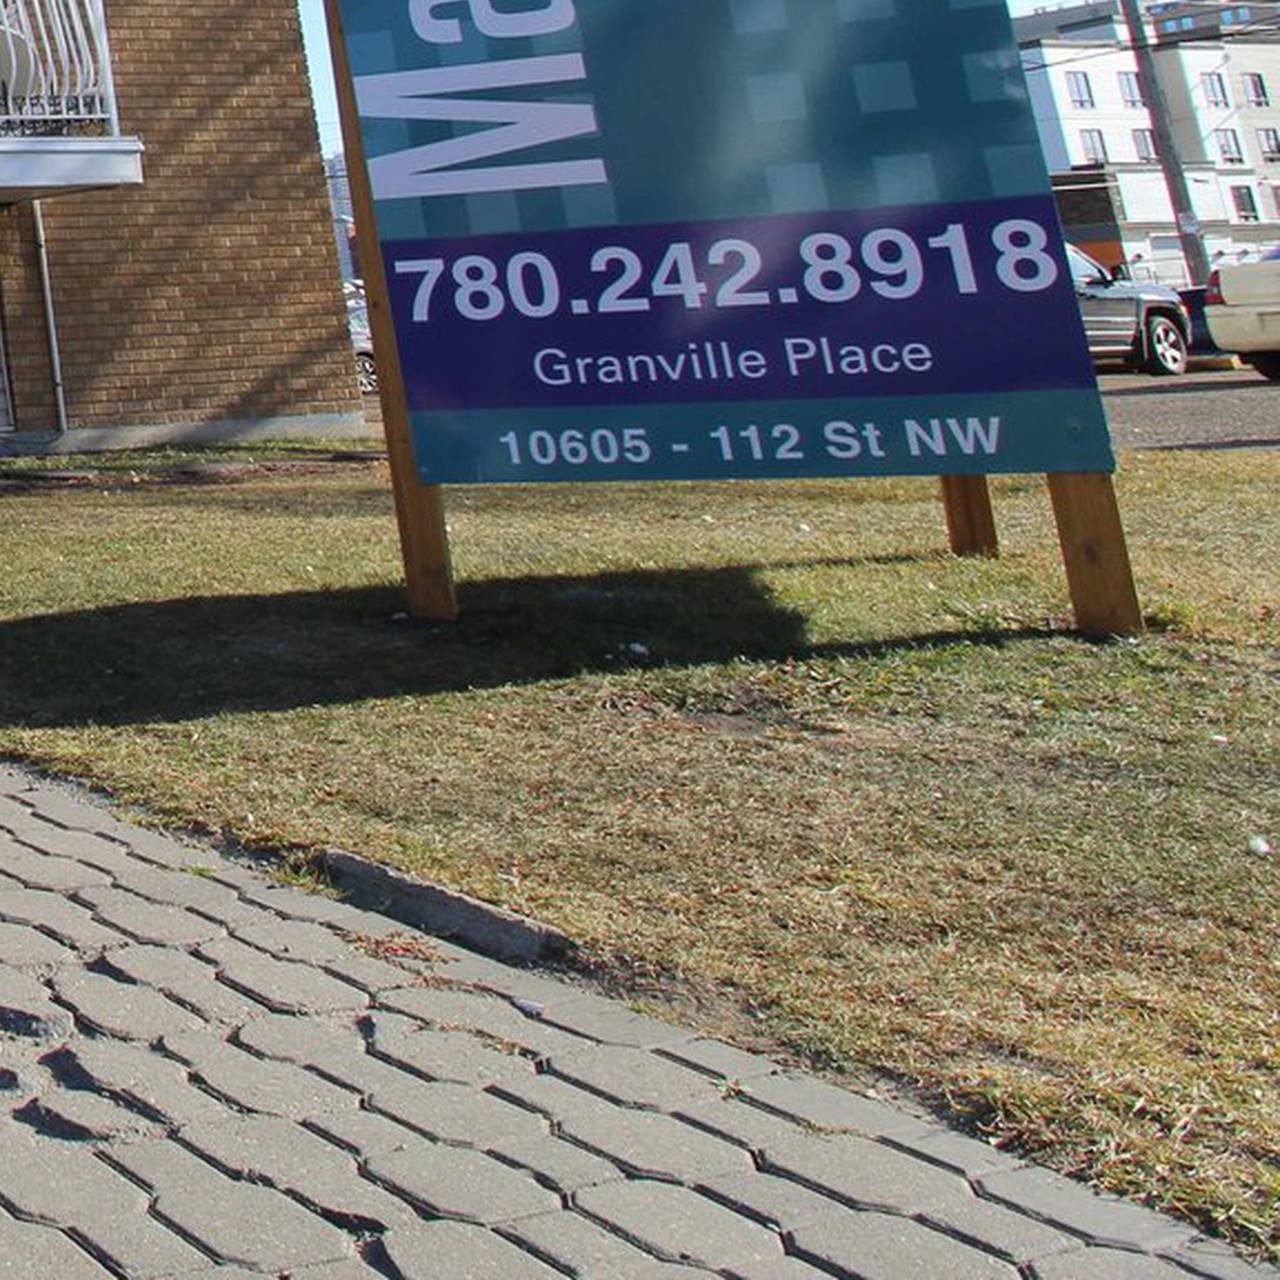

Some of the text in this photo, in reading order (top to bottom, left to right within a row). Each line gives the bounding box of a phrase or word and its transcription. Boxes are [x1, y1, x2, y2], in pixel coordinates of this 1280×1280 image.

[394, 217, 1058, 322] 780.242.8918
[533, 335, 934, 386] Granville Place
[498, 428, 651, 466] 10605
[710, 422, 803, 460] 112
[825, 418, 886, 459] St
[904, 416, 1001, 456] NW
